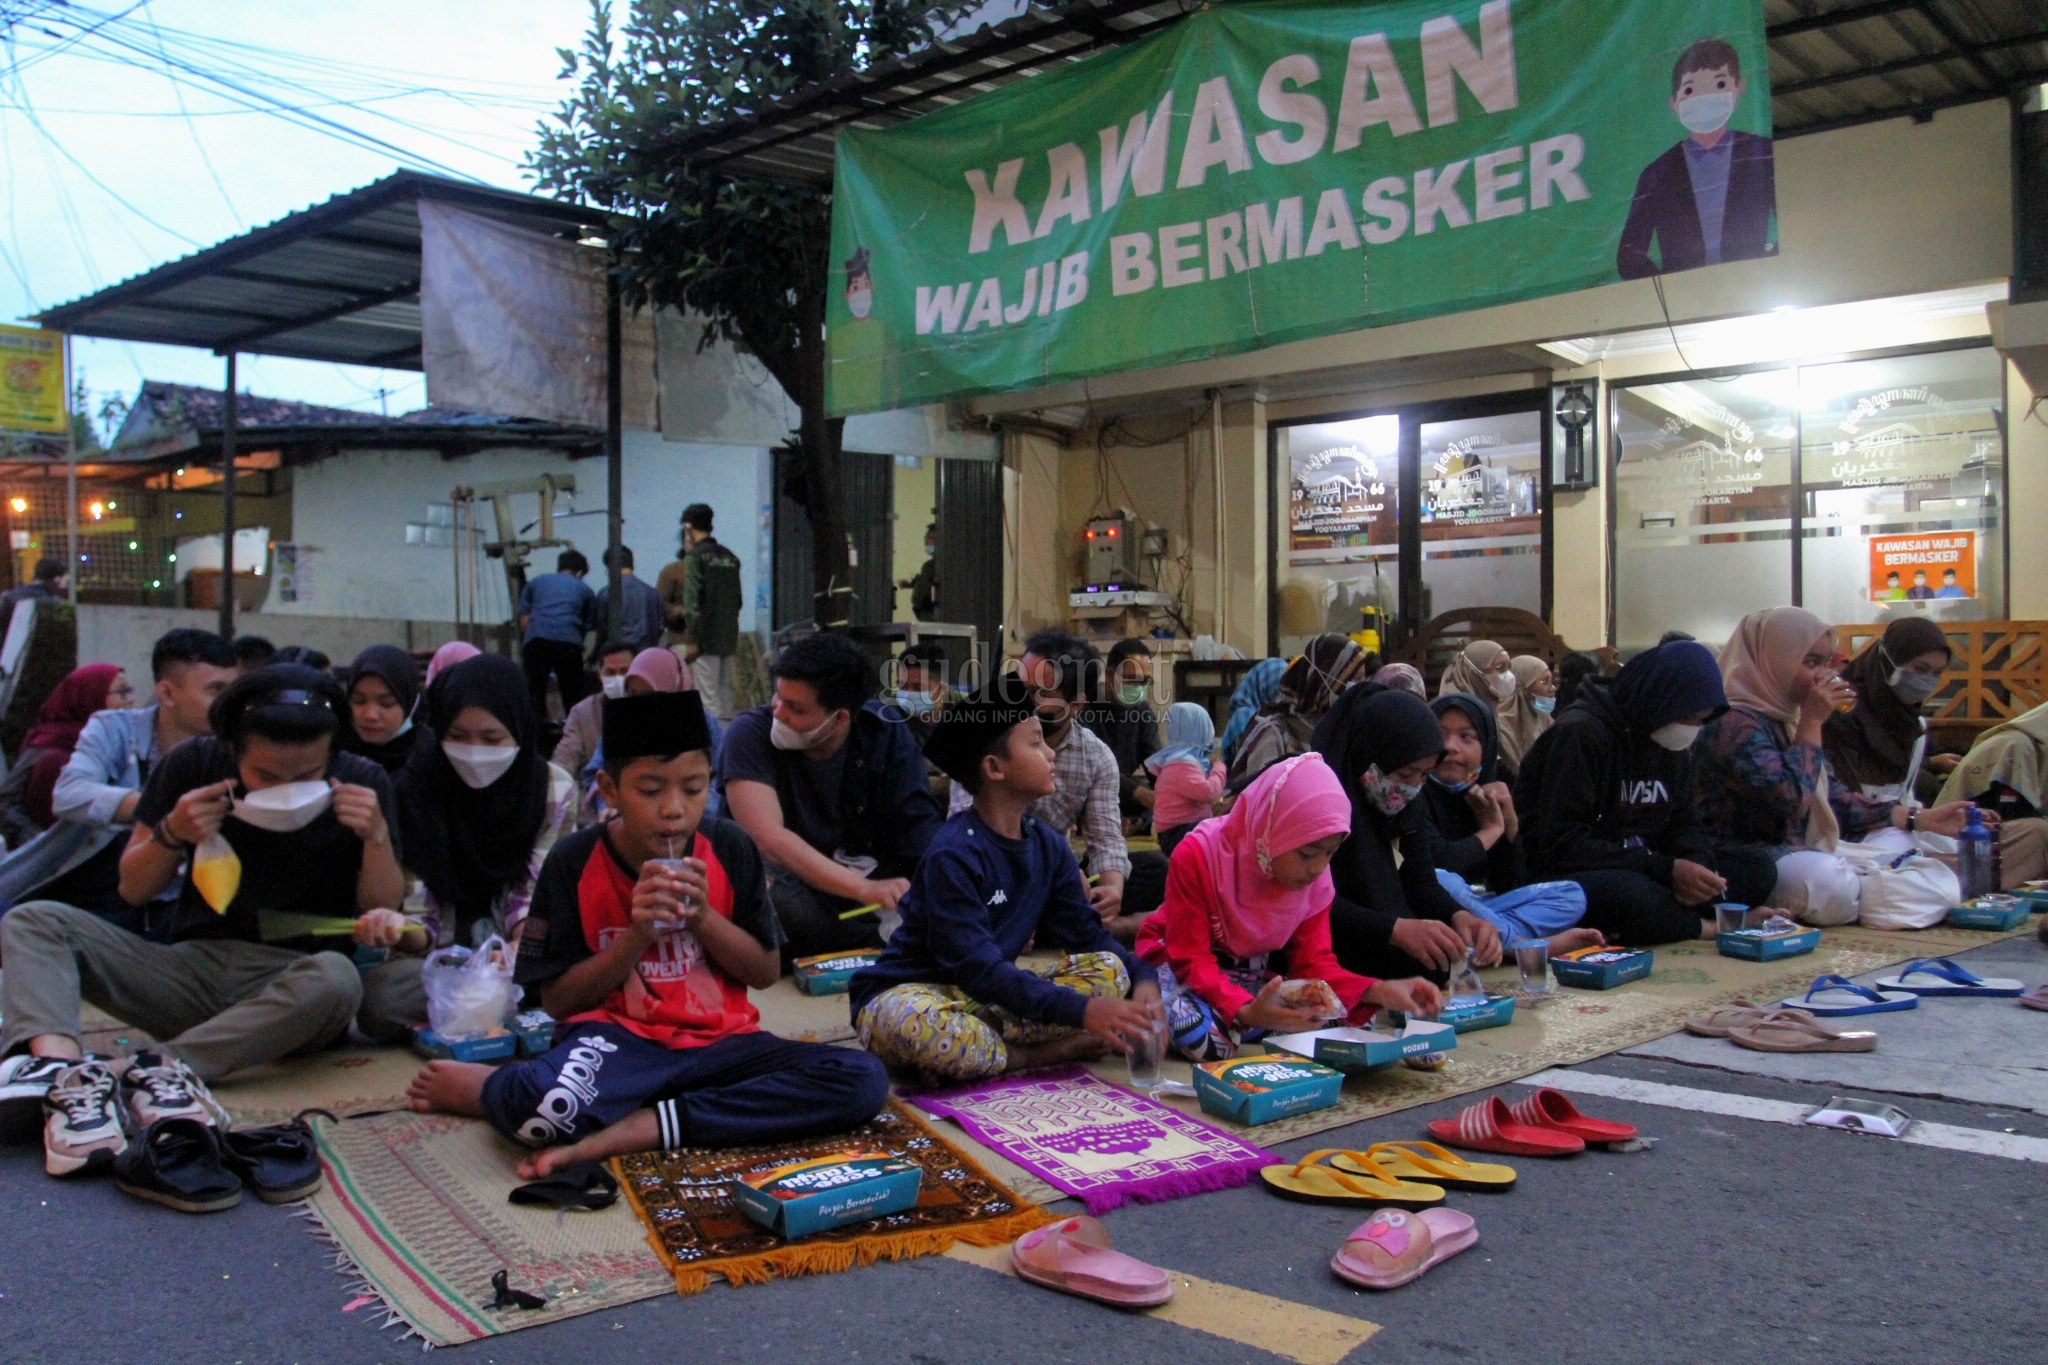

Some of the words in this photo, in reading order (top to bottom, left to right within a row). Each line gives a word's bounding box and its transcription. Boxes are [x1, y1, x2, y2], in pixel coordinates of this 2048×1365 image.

[964, 1, 1520, 254] KAWASAN
[915, 250, 1090, 335] WAJIB
[1109, 132, 1593, 297] BERMASKER
[1744, 448, 1764, 462] 66
[1428, 480, 1441, 492] 19
[1843, 477, 1880, 487] MASJID
[1291, 490, 1304, 501] 19
[1370, 482, 1385, 495] 66
[1436, 510, 1465, 519] MASJID
[1454, 517, 1504, 526] YOGYAKARTA
[1875, 540, 1930, 553] KAWASAN
[1932, 537, 1968, 550] WAJIB
[1884, 550, 1959, 566] BERMASKER
[1621, 780, 1669, 804] NASA
[1402, 1041, 1429, 1053] BERDOA
[1263, 1069, 1313, 1082] Sego
[517, 1046, 604, 1142] adida
[813, 1167, 883, 1189] Sego
